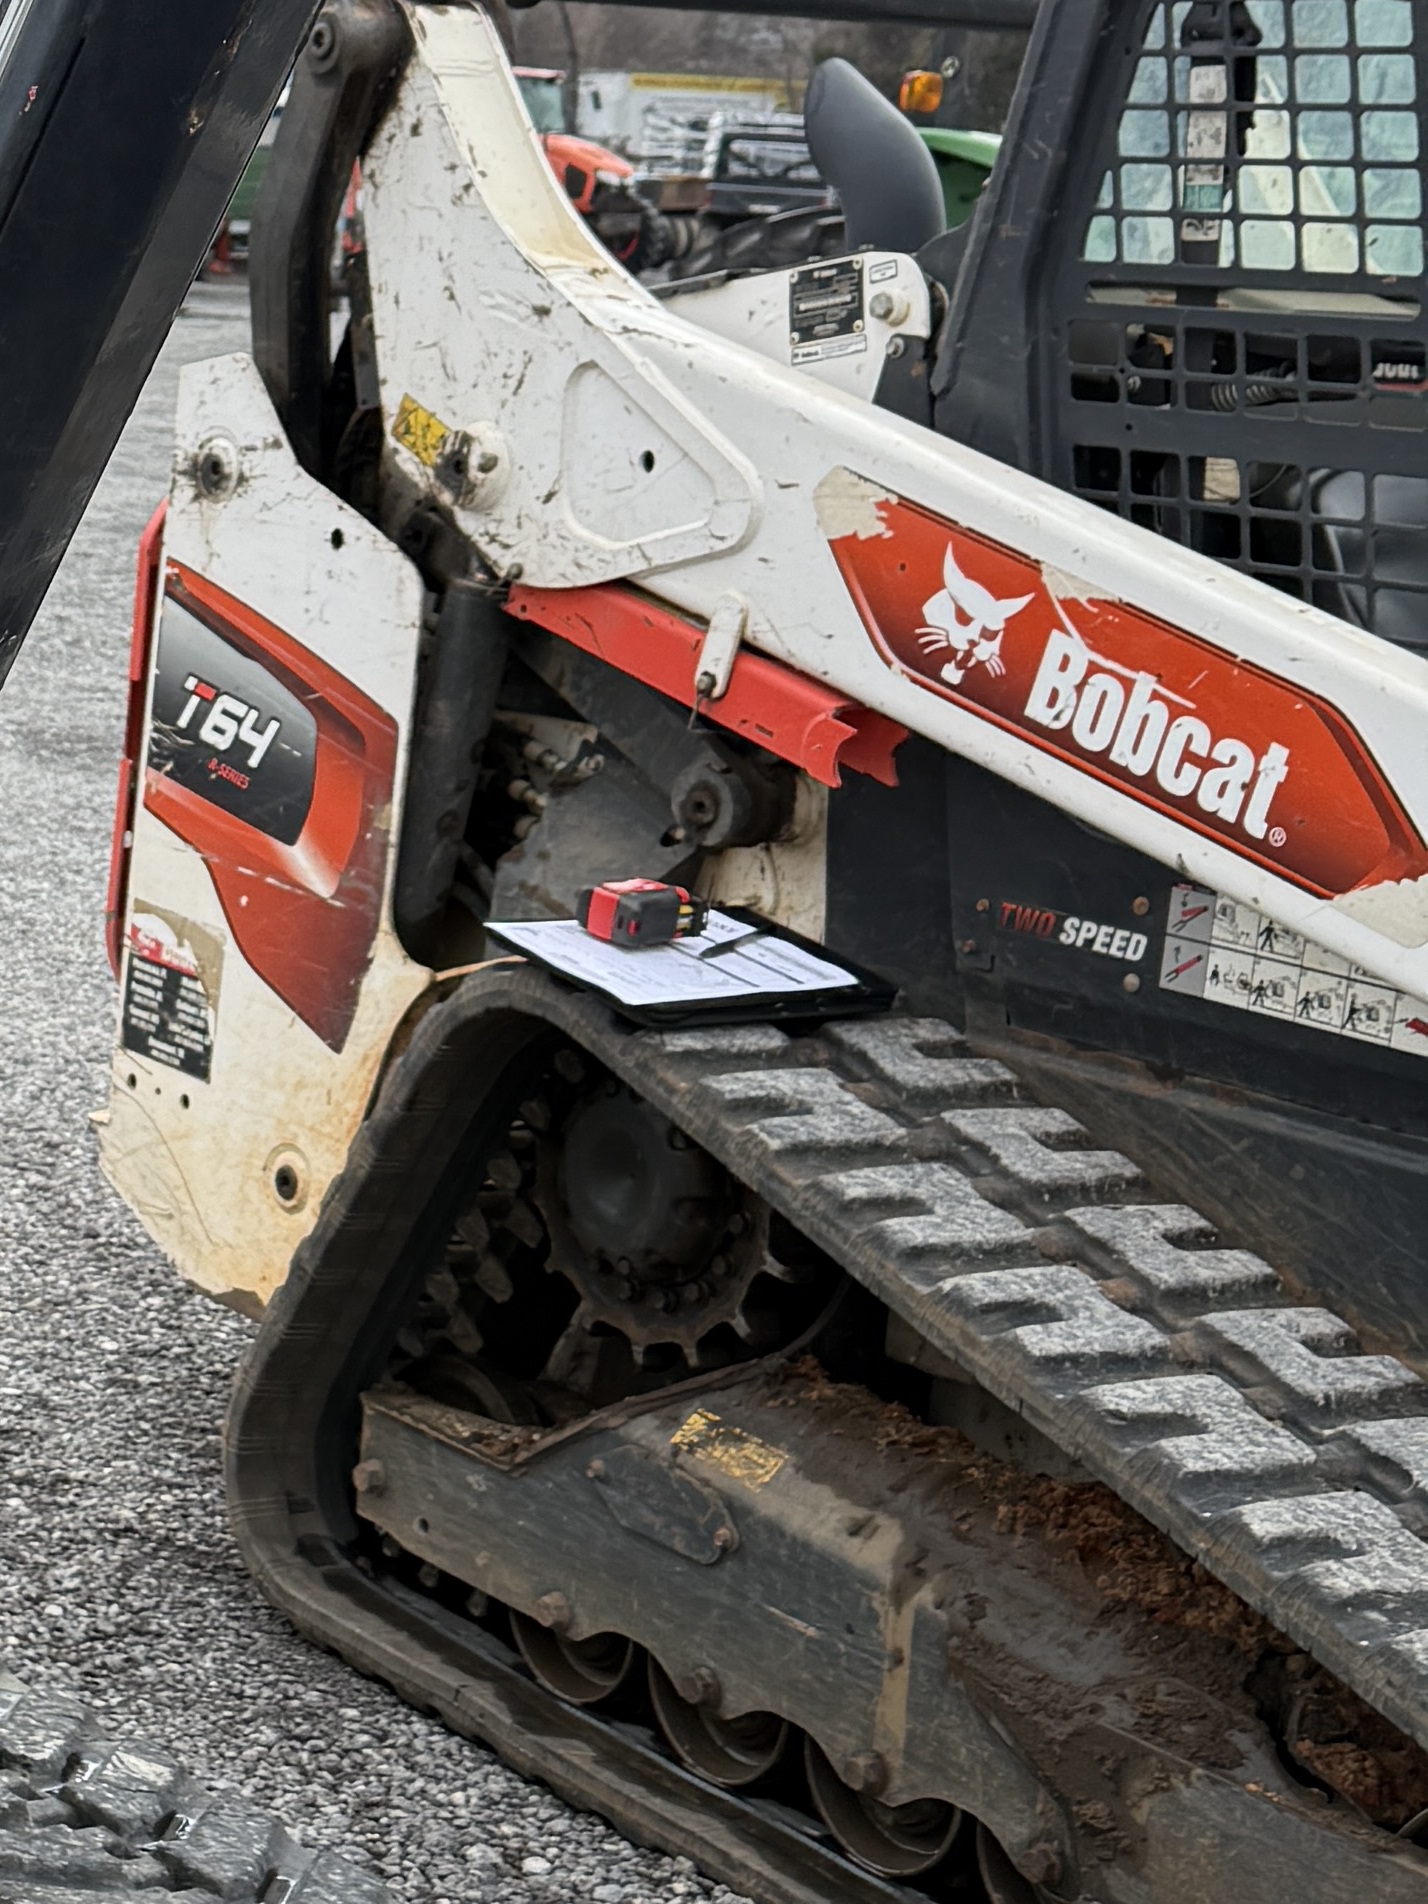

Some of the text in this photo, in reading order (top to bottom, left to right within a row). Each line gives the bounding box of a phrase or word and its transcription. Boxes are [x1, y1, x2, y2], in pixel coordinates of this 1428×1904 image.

[176, 675, 281, 769] T64
[1023, 628, 1290, 840] Bobcat
[1000, 901, 1149, 962] TWO SPEED
